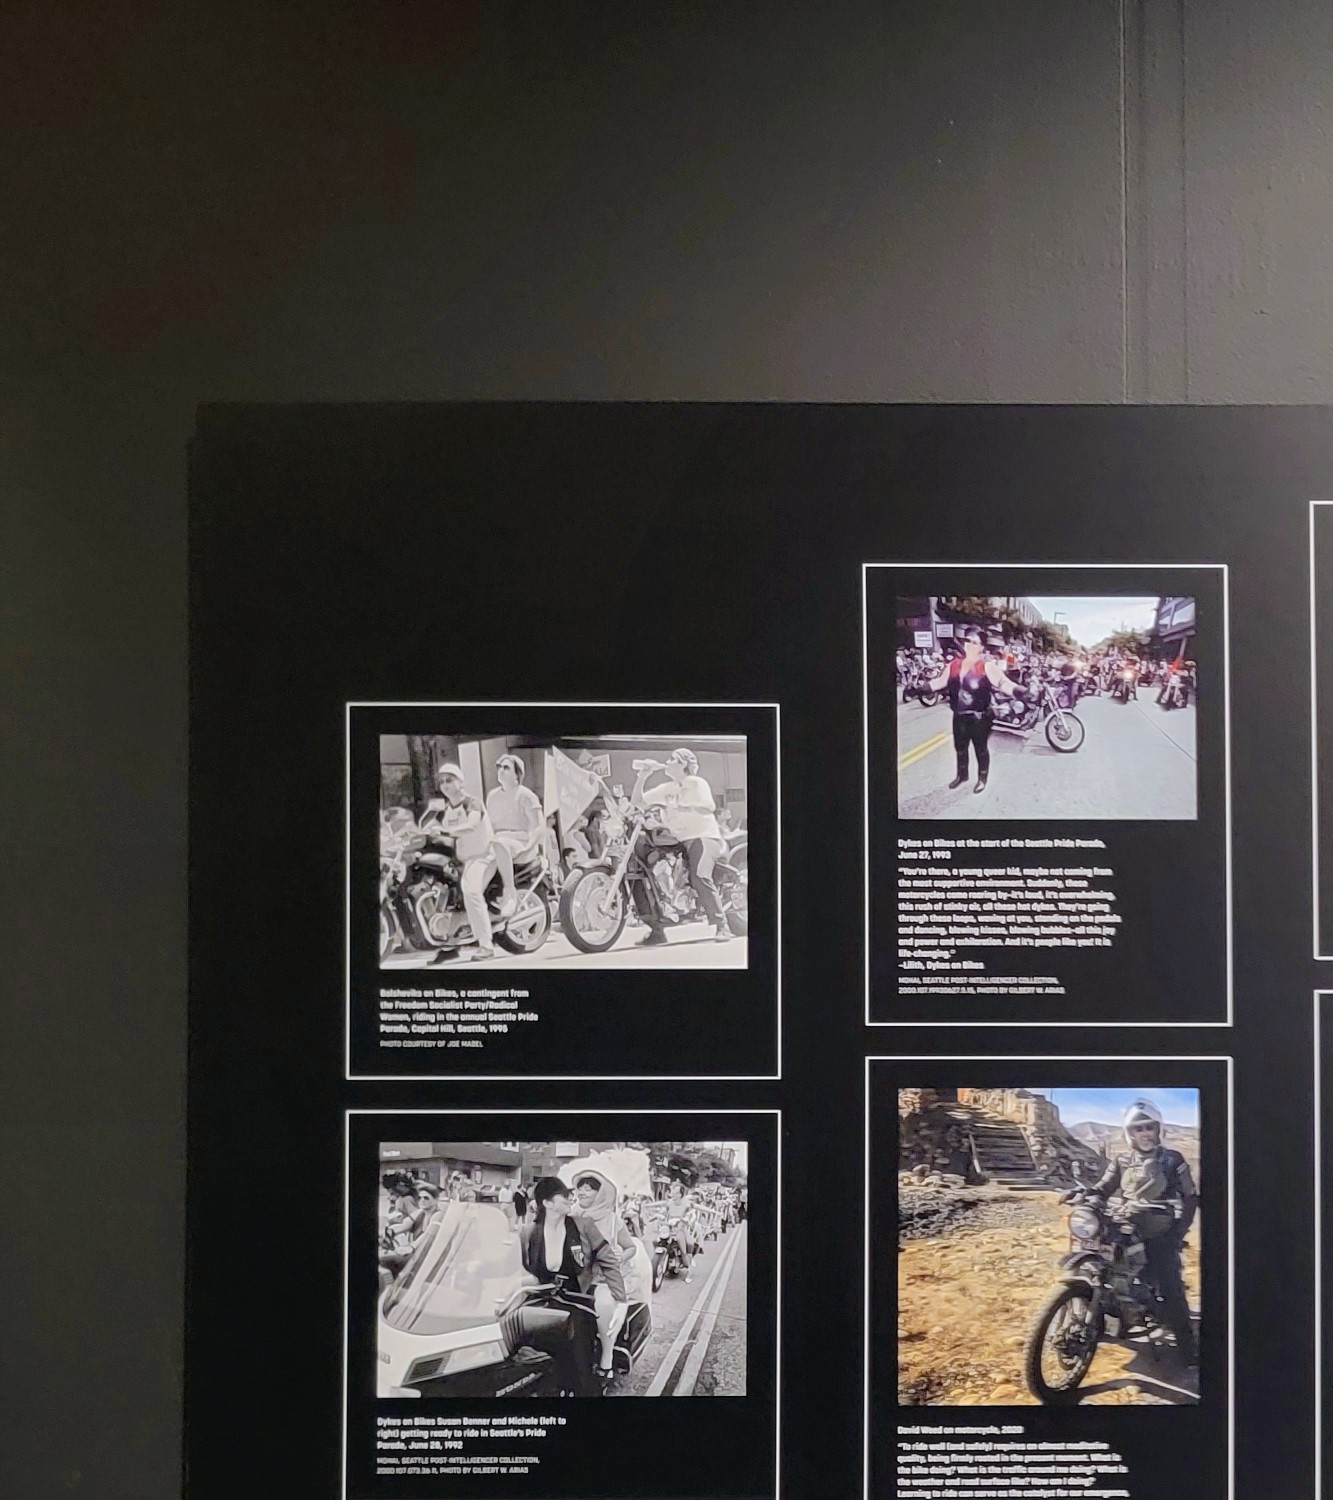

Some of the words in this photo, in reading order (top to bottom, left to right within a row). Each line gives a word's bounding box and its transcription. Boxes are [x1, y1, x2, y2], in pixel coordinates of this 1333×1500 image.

[380, 989, 422, 997] Bolsheviks
[435, 989, 458, 998] Bikes,
[467, 989, 509, 999] contingent
[510, 989, 529, 997] from
[380, 1001, 393, 1009] the
[395, 1001, 428, 1009] Freedom
[429, 1001, 463, 1009] Socialist
[465, 1001, 518, 1011] Party/Radical
[380, 1013, 410, 1022] Women,
[412, 1013, 435, 1023] riding
[437, 1013, 444, 1021] in
[446, 1013, 459, 1021] the
[460, 1013, 487, 1021] annual
[488, 1013, 516, 1021] Seattle
[518, 1012, 538, 1021] Pride
[380, 1025, 409, 1033] Parade,
[411, 1024, 439, 1034] Capitol
[440, 1024, 455, 1033] Hill,
[457, 1024, 487, 1033] Seattle,
